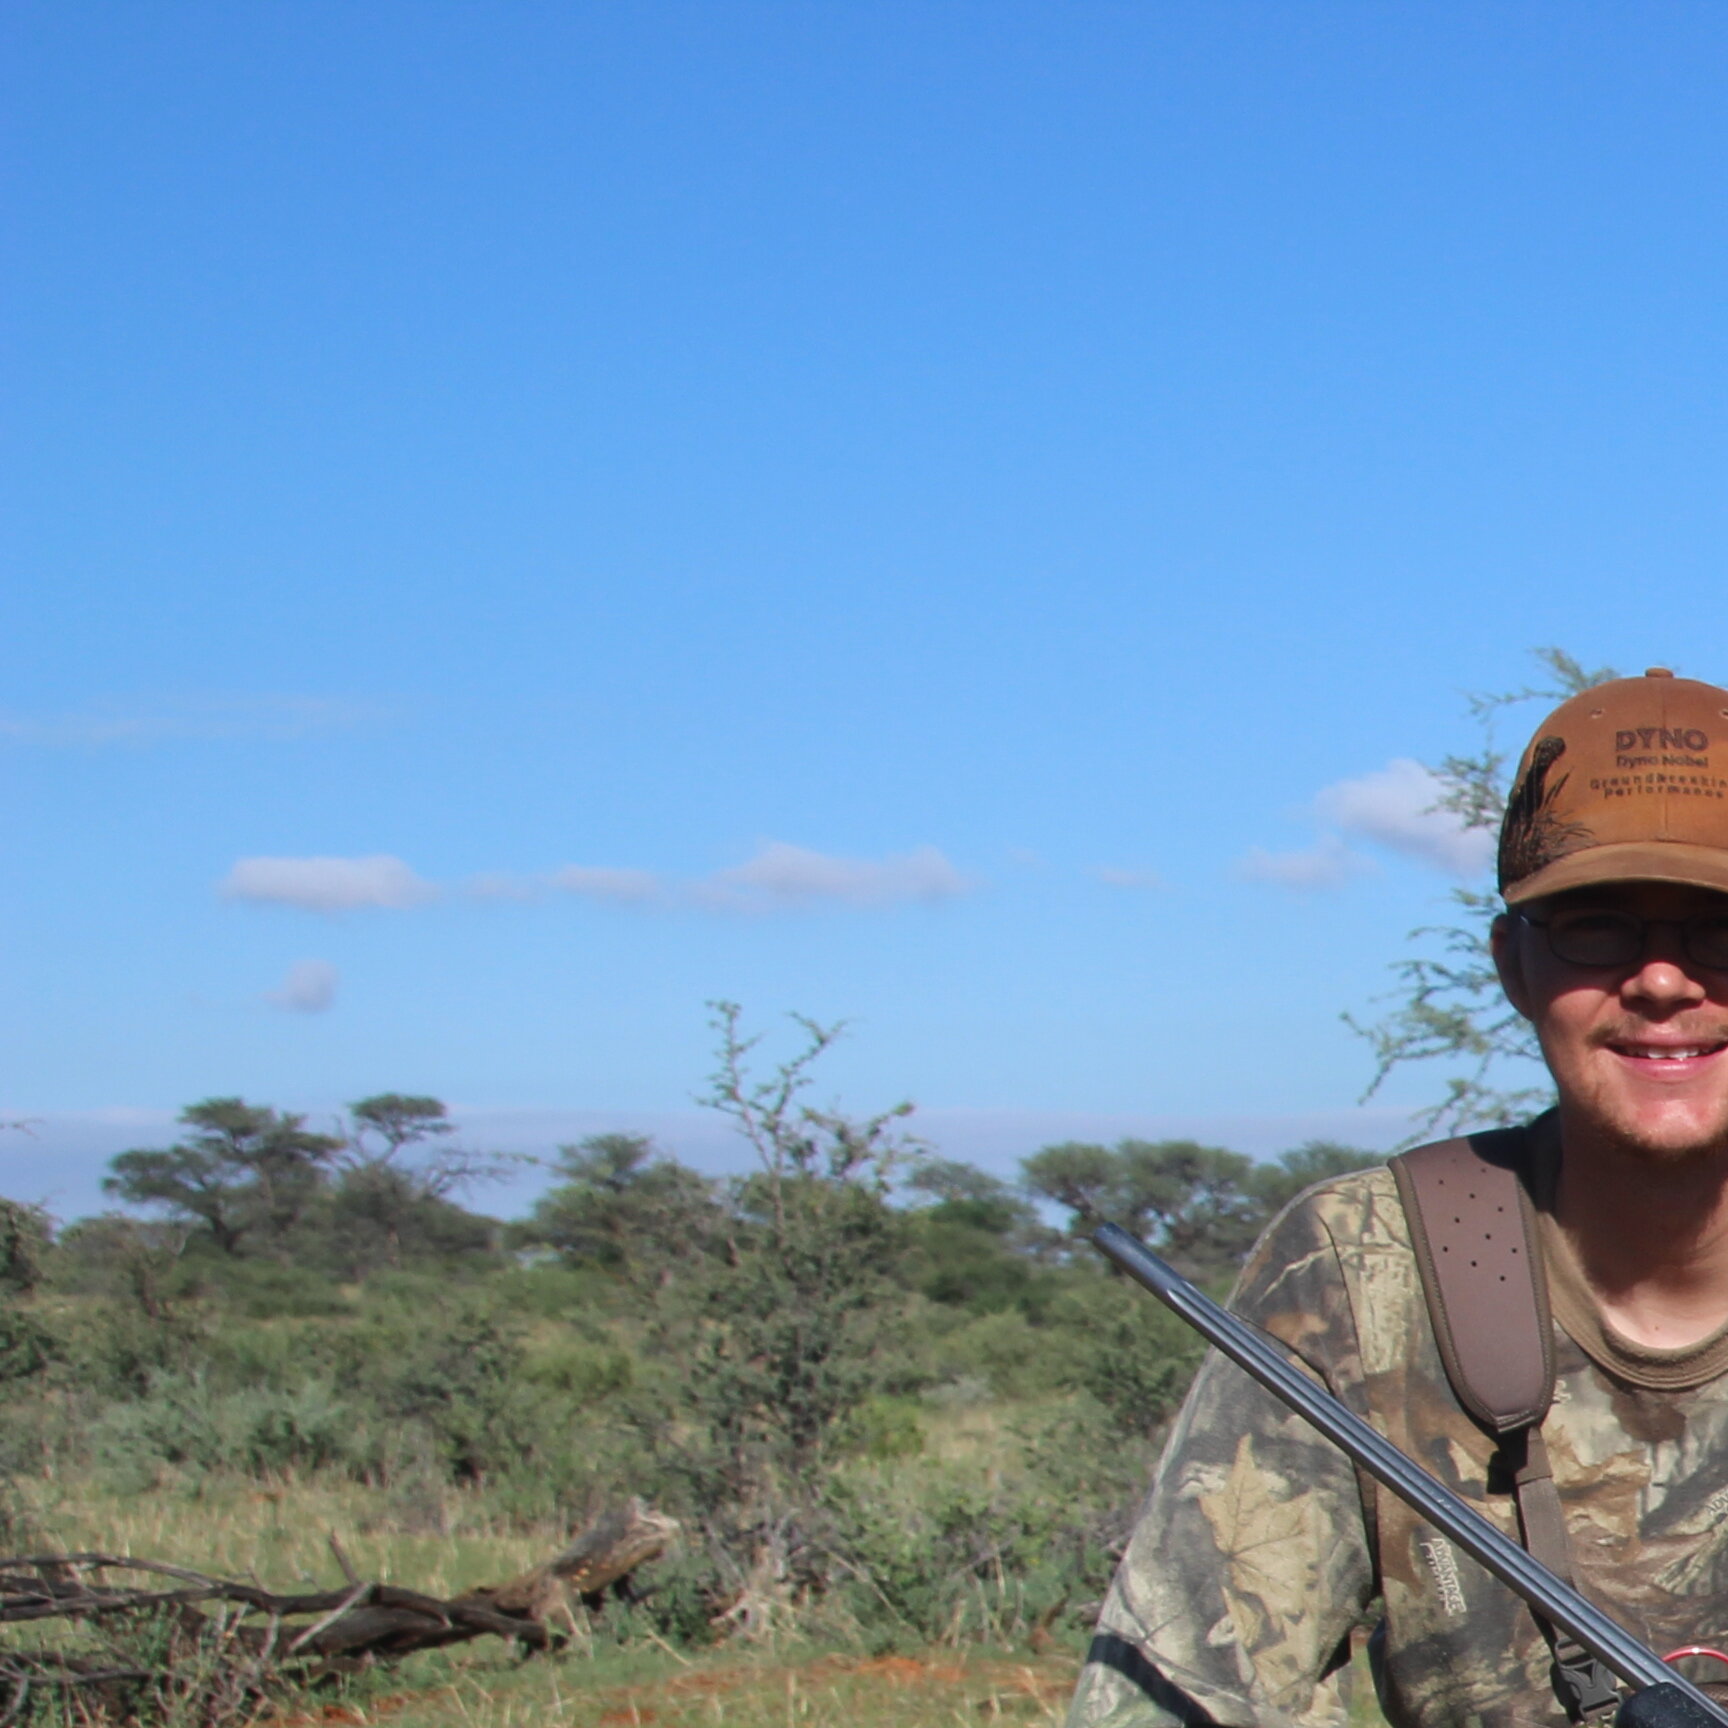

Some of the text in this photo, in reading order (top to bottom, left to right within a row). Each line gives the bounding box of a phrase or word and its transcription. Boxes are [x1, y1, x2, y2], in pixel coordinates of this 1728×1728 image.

[1615, 727, 1710, 751] DYNO
[1616, 755, 1709, 769] Dyno Nobel
